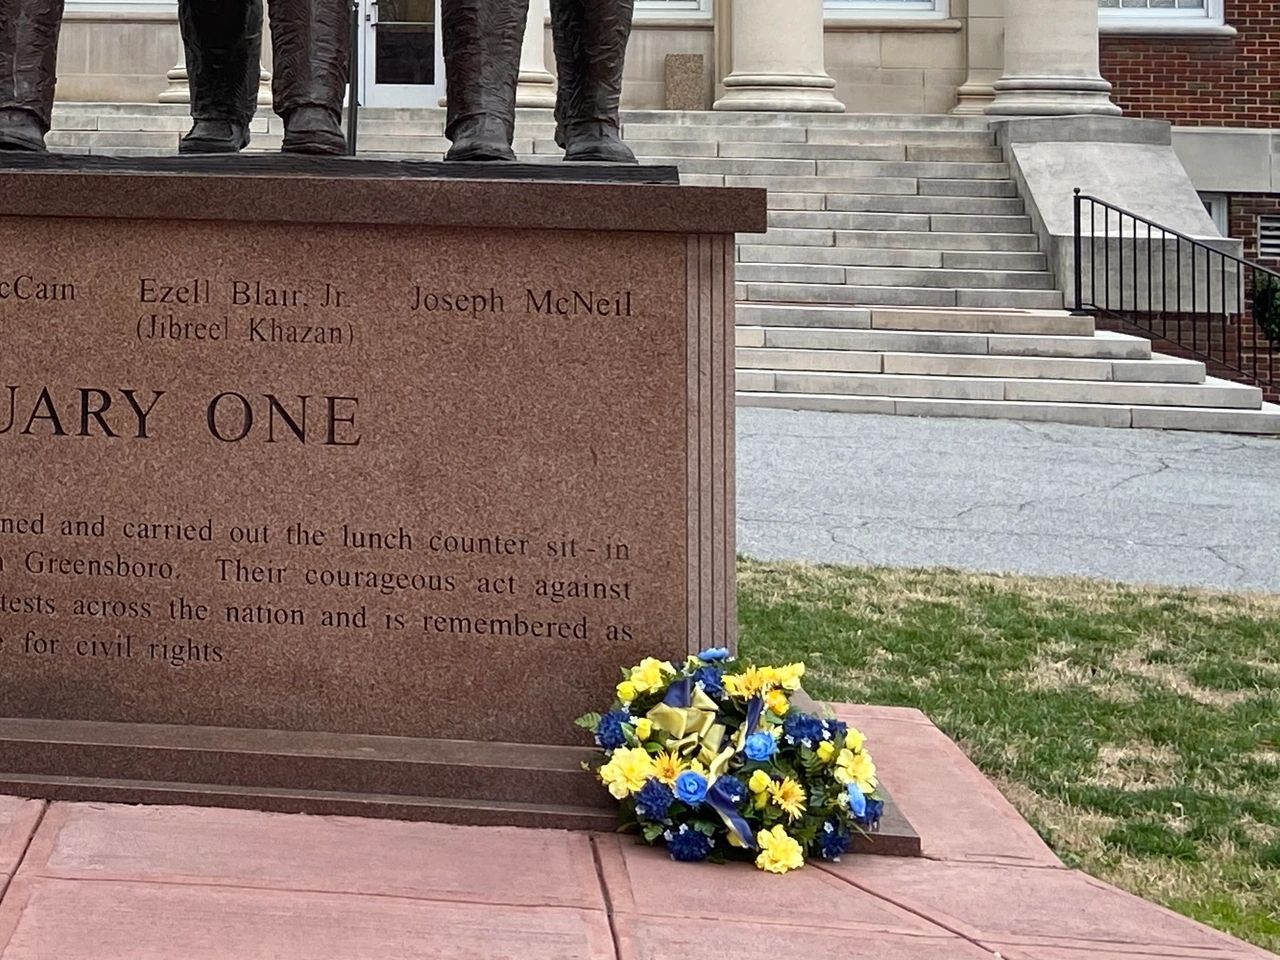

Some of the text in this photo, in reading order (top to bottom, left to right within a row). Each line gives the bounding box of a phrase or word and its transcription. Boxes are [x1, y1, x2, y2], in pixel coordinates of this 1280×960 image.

[138, 278, 211, 305] Ezell
[320, 282, 351, 310] Jr.
[410, 285, 633, 319] Joseph McNeil
[136, 316, 355, 345] (Jibreel Khazan)
[206, 390, 362, 447] ONE
[60, 515, 106, 538] and
[122, 518, 214, 542] carried
[229, 525, 270, 545] out
[286, 523, 326, 547] the
[342, 524, 414, 551] lunch
[429, 532, 531, 556] counter
[24, 549, 182, 581] Greensboro.
[215, 557, 287, 585] Their
[305, 567, 457, 597] courageous
[476, 573, 517, 596] act
[534, 573, 632, 604] against
[72, 597, 153, 620] across
[168, 597, 209, 622] the
[224, 600, 305, 626] nation
[320, 606, 368, 629] and
[384, 612, 407, 632] is
[423, 611, 589, 640] remembered
[605, 620, 634, 642] as
[23, 630, 61, 656] for
[75, 633, 133, 660] civil
[149, 635, 230, 668] rights.
